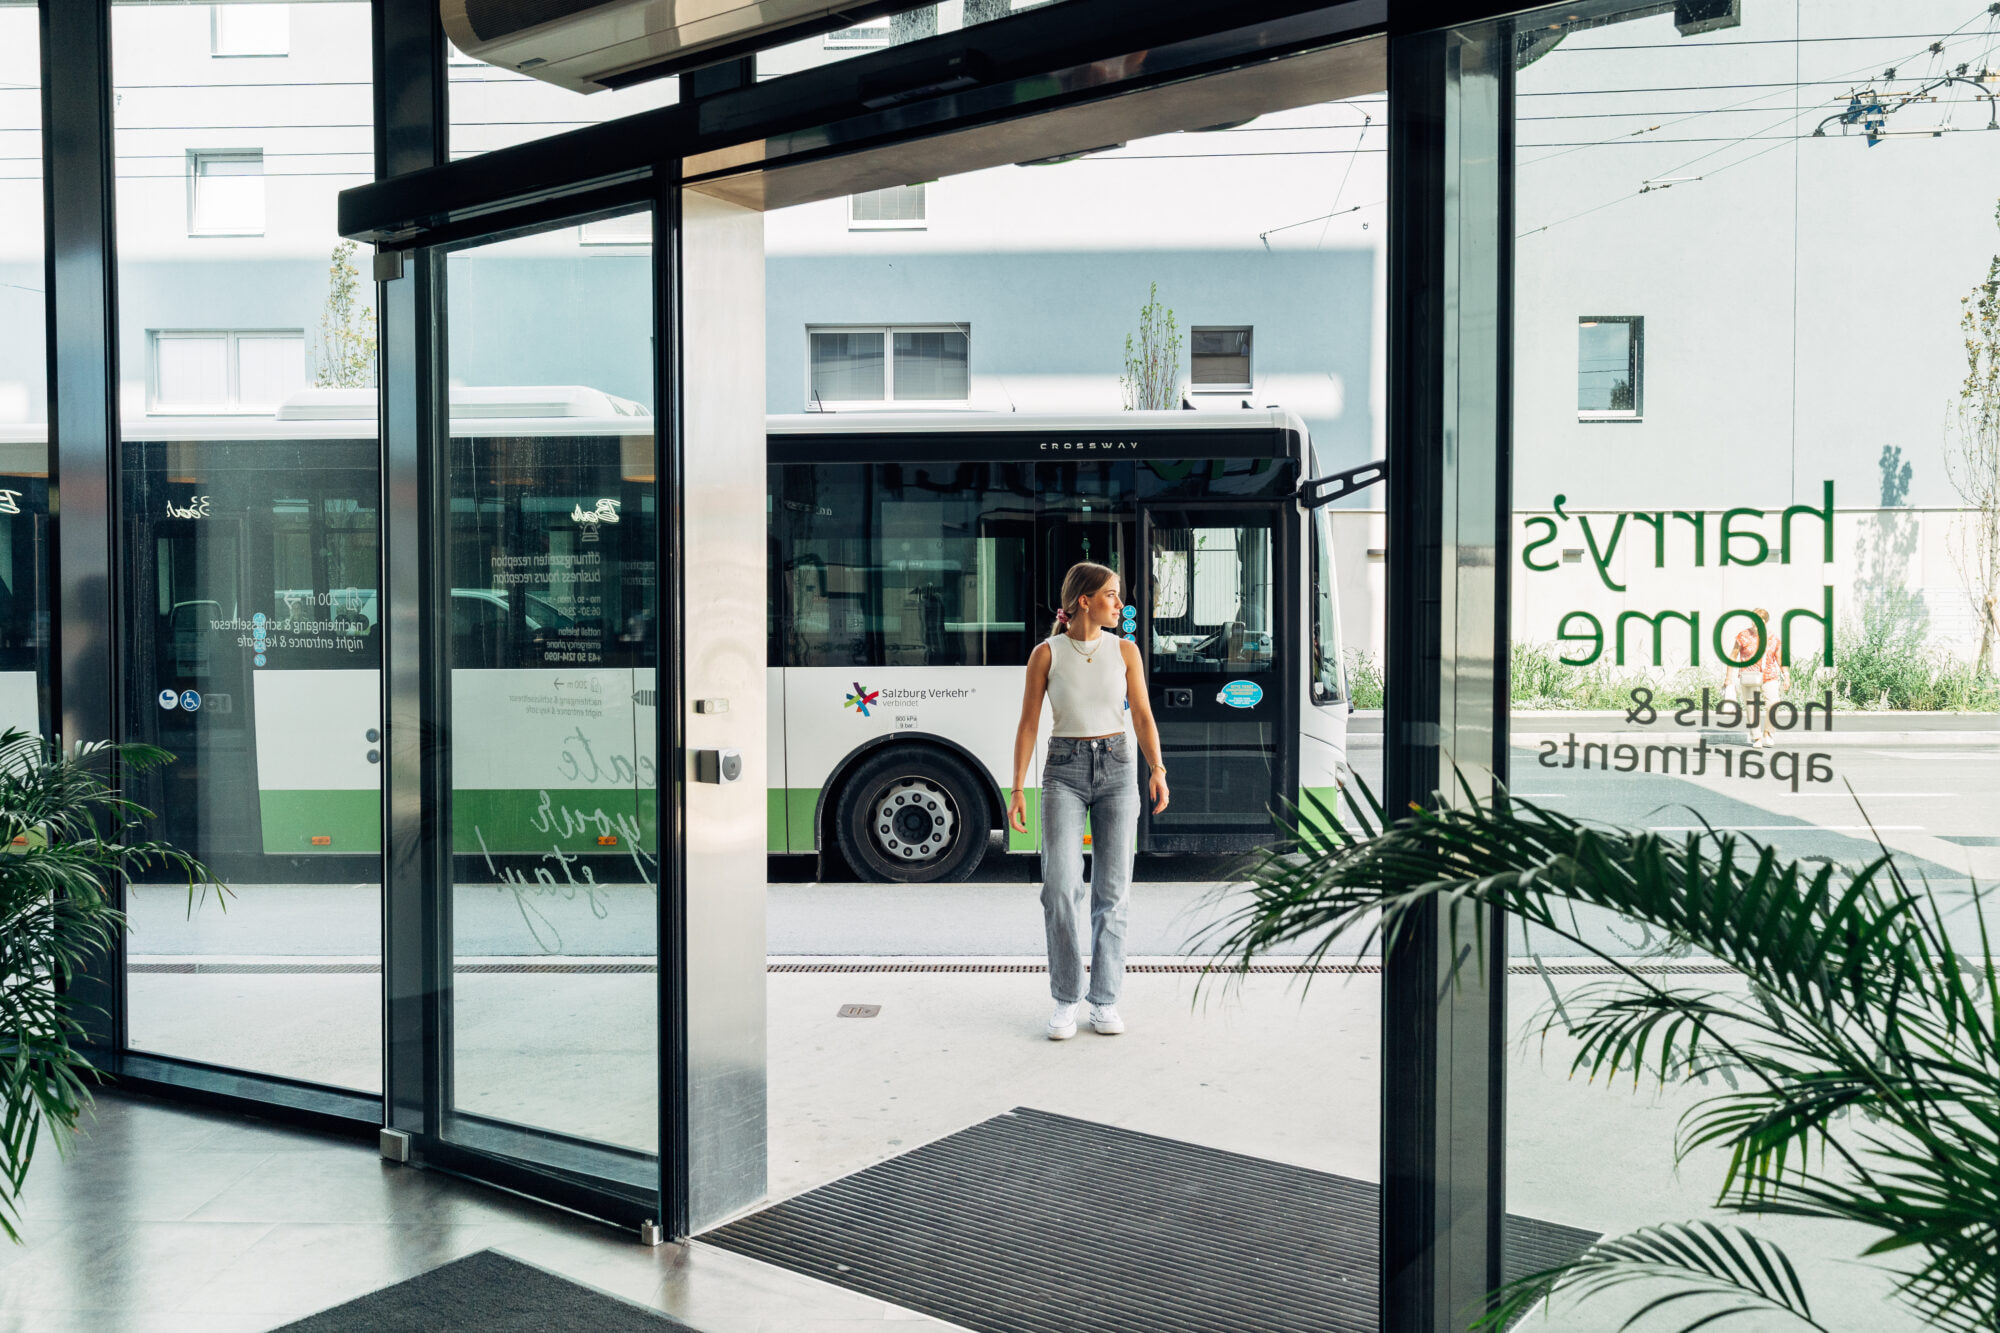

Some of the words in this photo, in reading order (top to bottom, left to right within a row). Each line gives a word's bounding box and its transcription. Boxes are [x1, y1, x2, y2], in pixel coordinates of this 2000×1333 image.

[1040, 442, 1138, 450] CROSSWAY
[882, 688, 927, 699] Salzburg
[928, 688, 969, 699] Verkehr
[882, 699, 918, 707] verbindet
